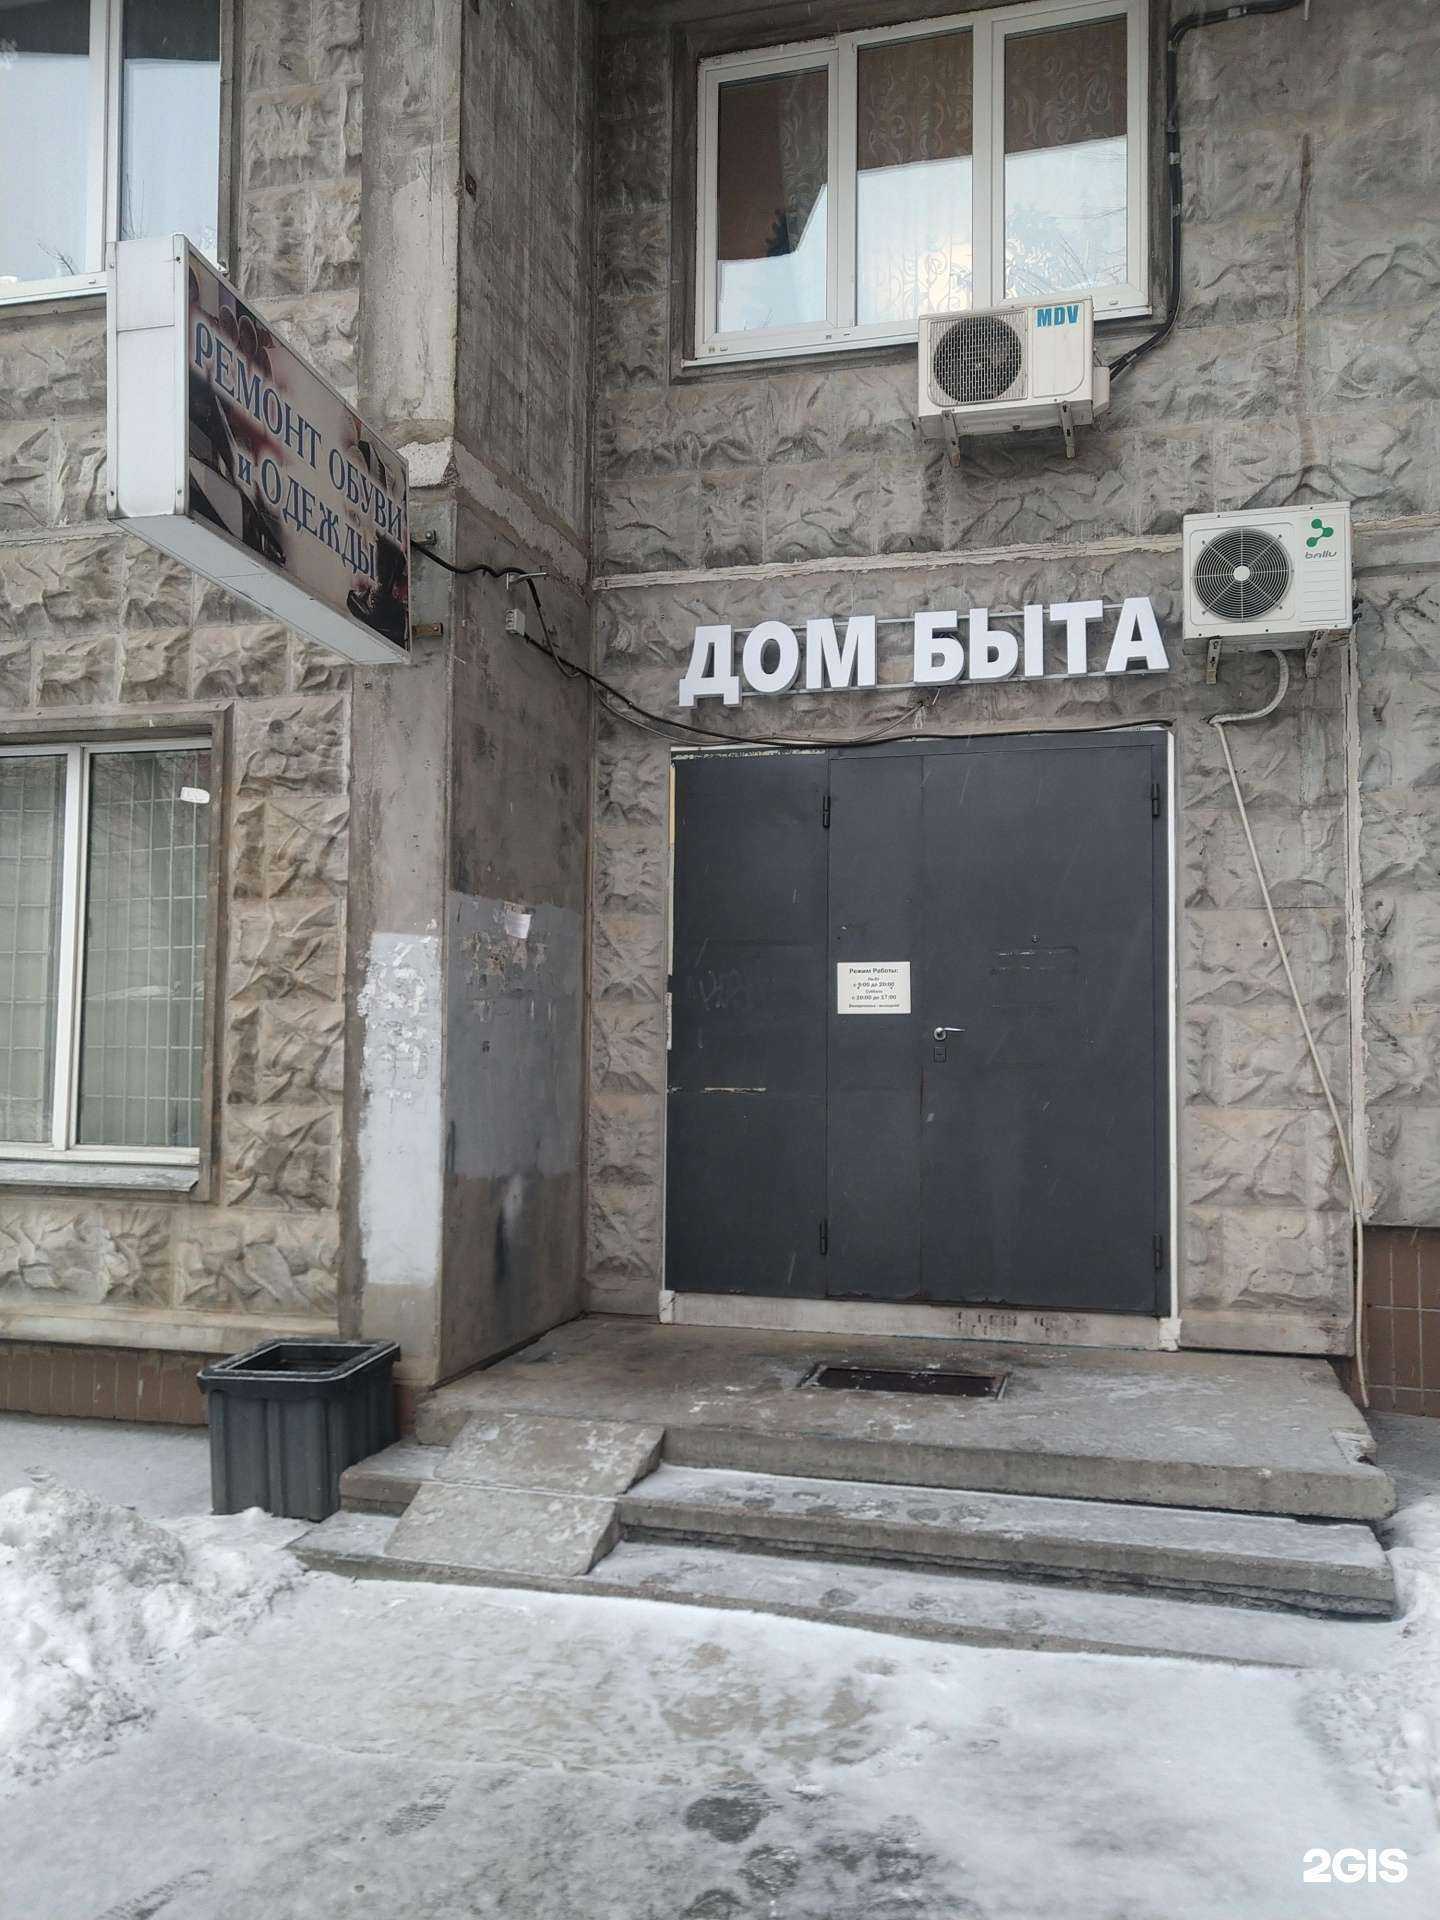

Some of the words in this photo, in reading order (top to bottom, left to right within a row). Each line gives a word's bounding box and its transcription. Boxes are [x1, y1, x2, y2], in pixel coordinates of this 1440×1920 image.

[1037, 304, 1079, 328] MDV
[194, 320, 322, 470] РЕМОНТ
[328, 447, 404, 544] ОБУВИ
[238, 452, 252, 486] и
[261, 458, 377, 582] ОДЕЖДЫ
[678, 614, 877, 708] ДОМ
[913, 596, 1170, 685] БЫТА
